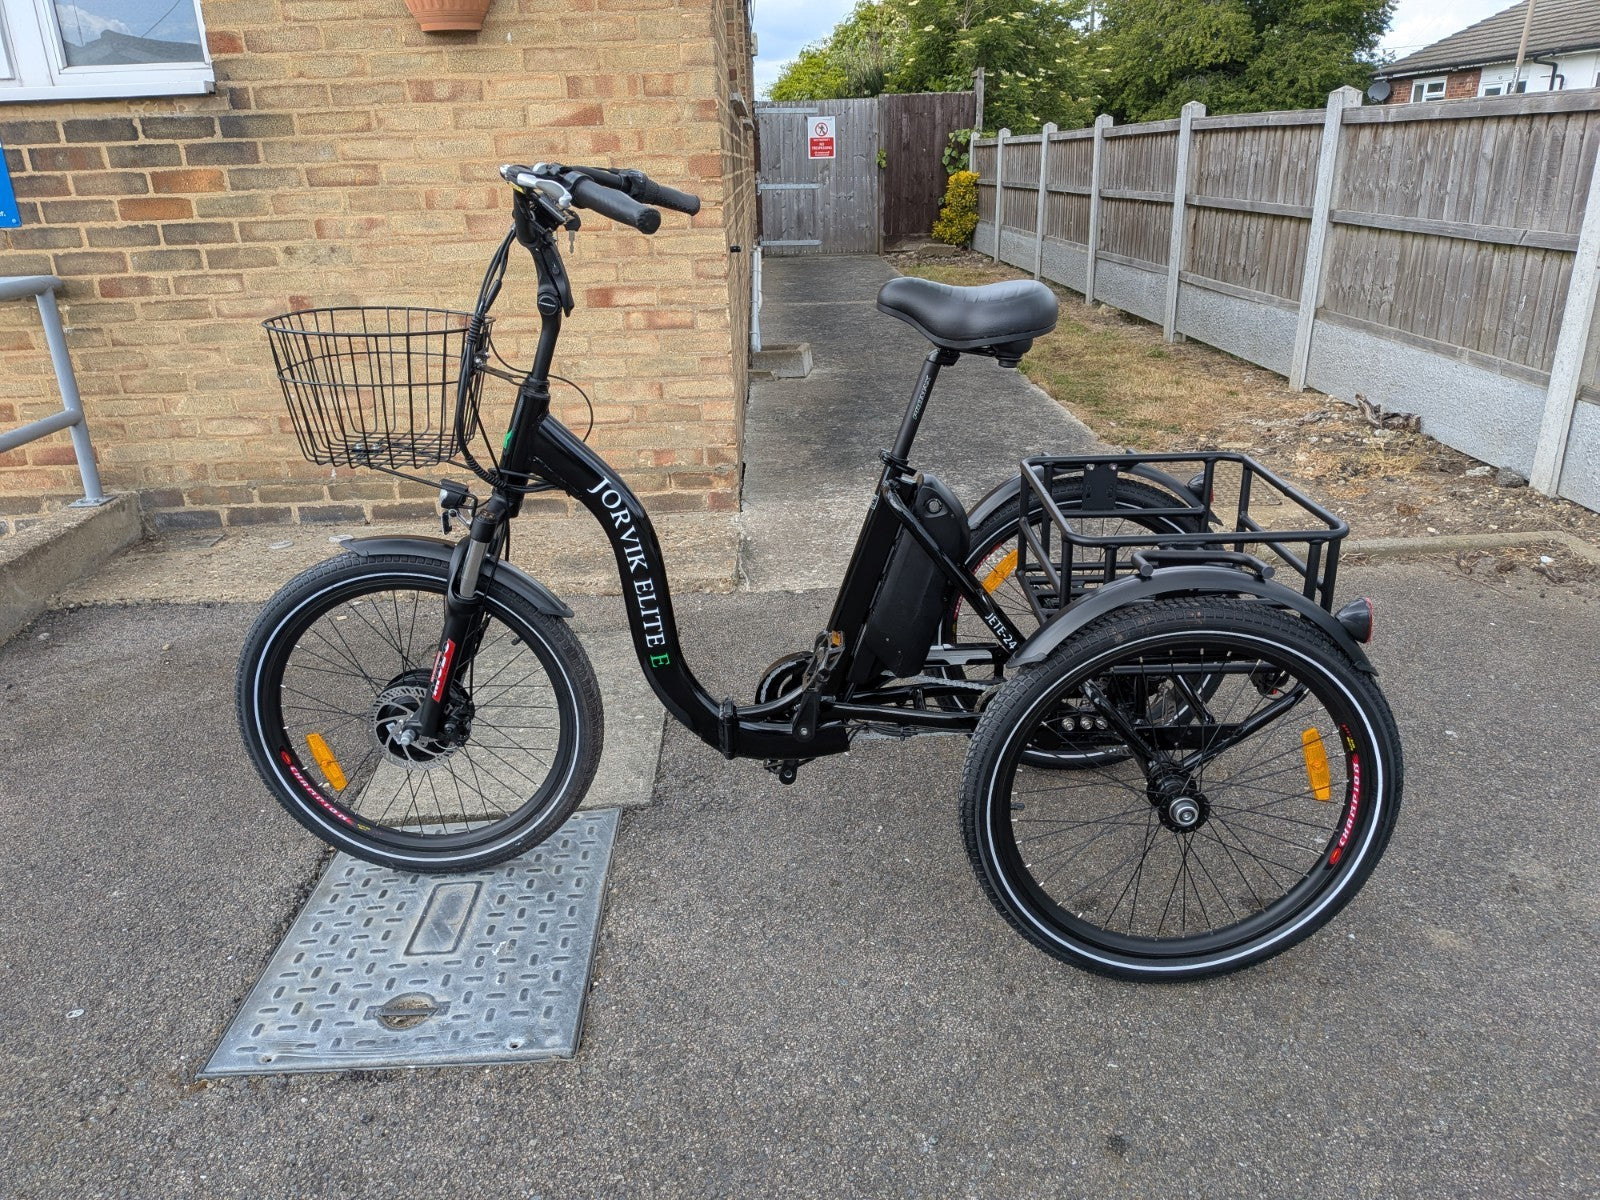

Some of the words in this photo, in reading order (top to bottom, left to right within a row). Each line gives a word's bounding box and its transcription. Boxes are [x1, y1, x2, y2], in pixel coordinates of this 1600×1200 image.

[587, 476, 648, 574] JORVIK
[633, 577, 665, 648] ELITE
[650, 652, 670, 668] E
[985, 612, 1017, 649] JETE-24
[289, 765, 348, 821] CHAMPION
[1338, 762, 1360, 848] CHAMPION
